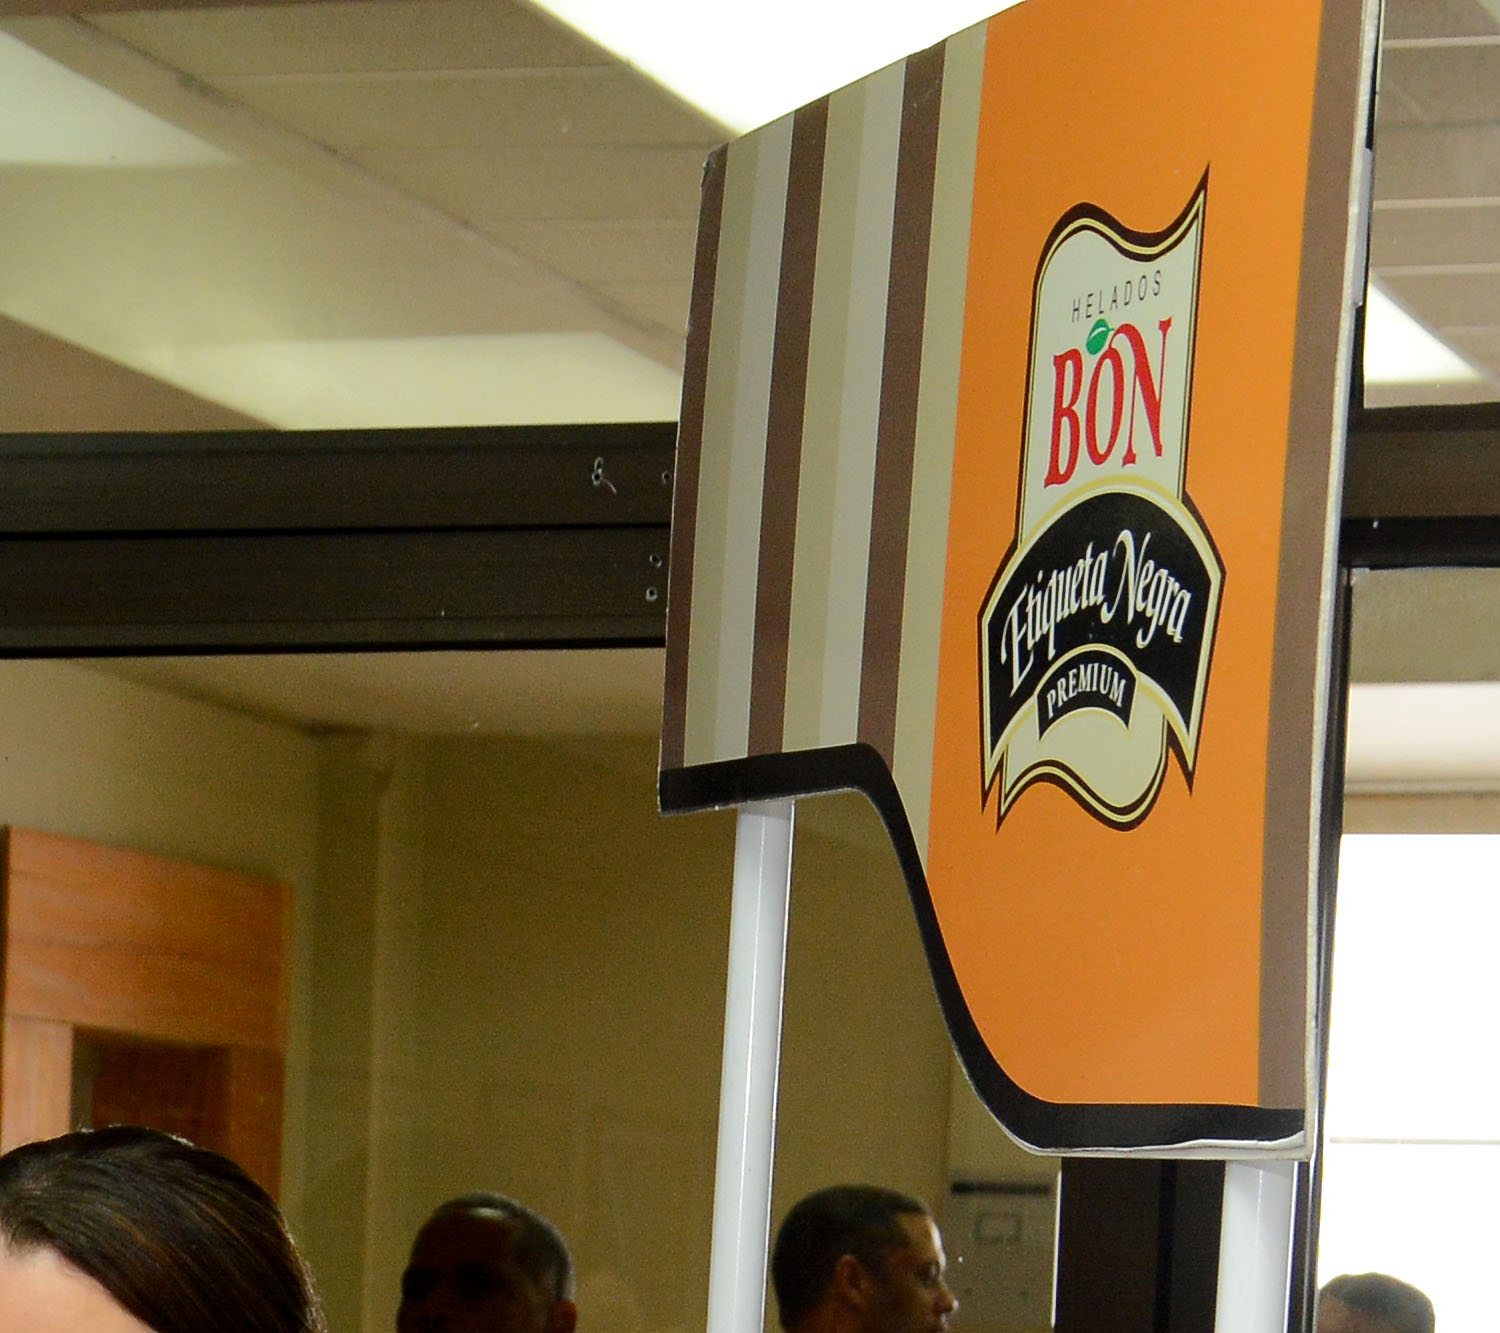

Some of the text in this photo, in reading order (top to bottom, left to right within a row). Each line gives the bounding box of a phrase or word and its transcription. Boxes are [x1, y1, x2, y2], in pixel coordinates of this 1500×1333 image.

[1071, 269, 1161, 323] HELADOS
[1044, 316, 1172, 488] BON
[1001, 529, 1191, 697] Etiqueta Negra
[1047, 663, 1126, 718] PREMIUM
